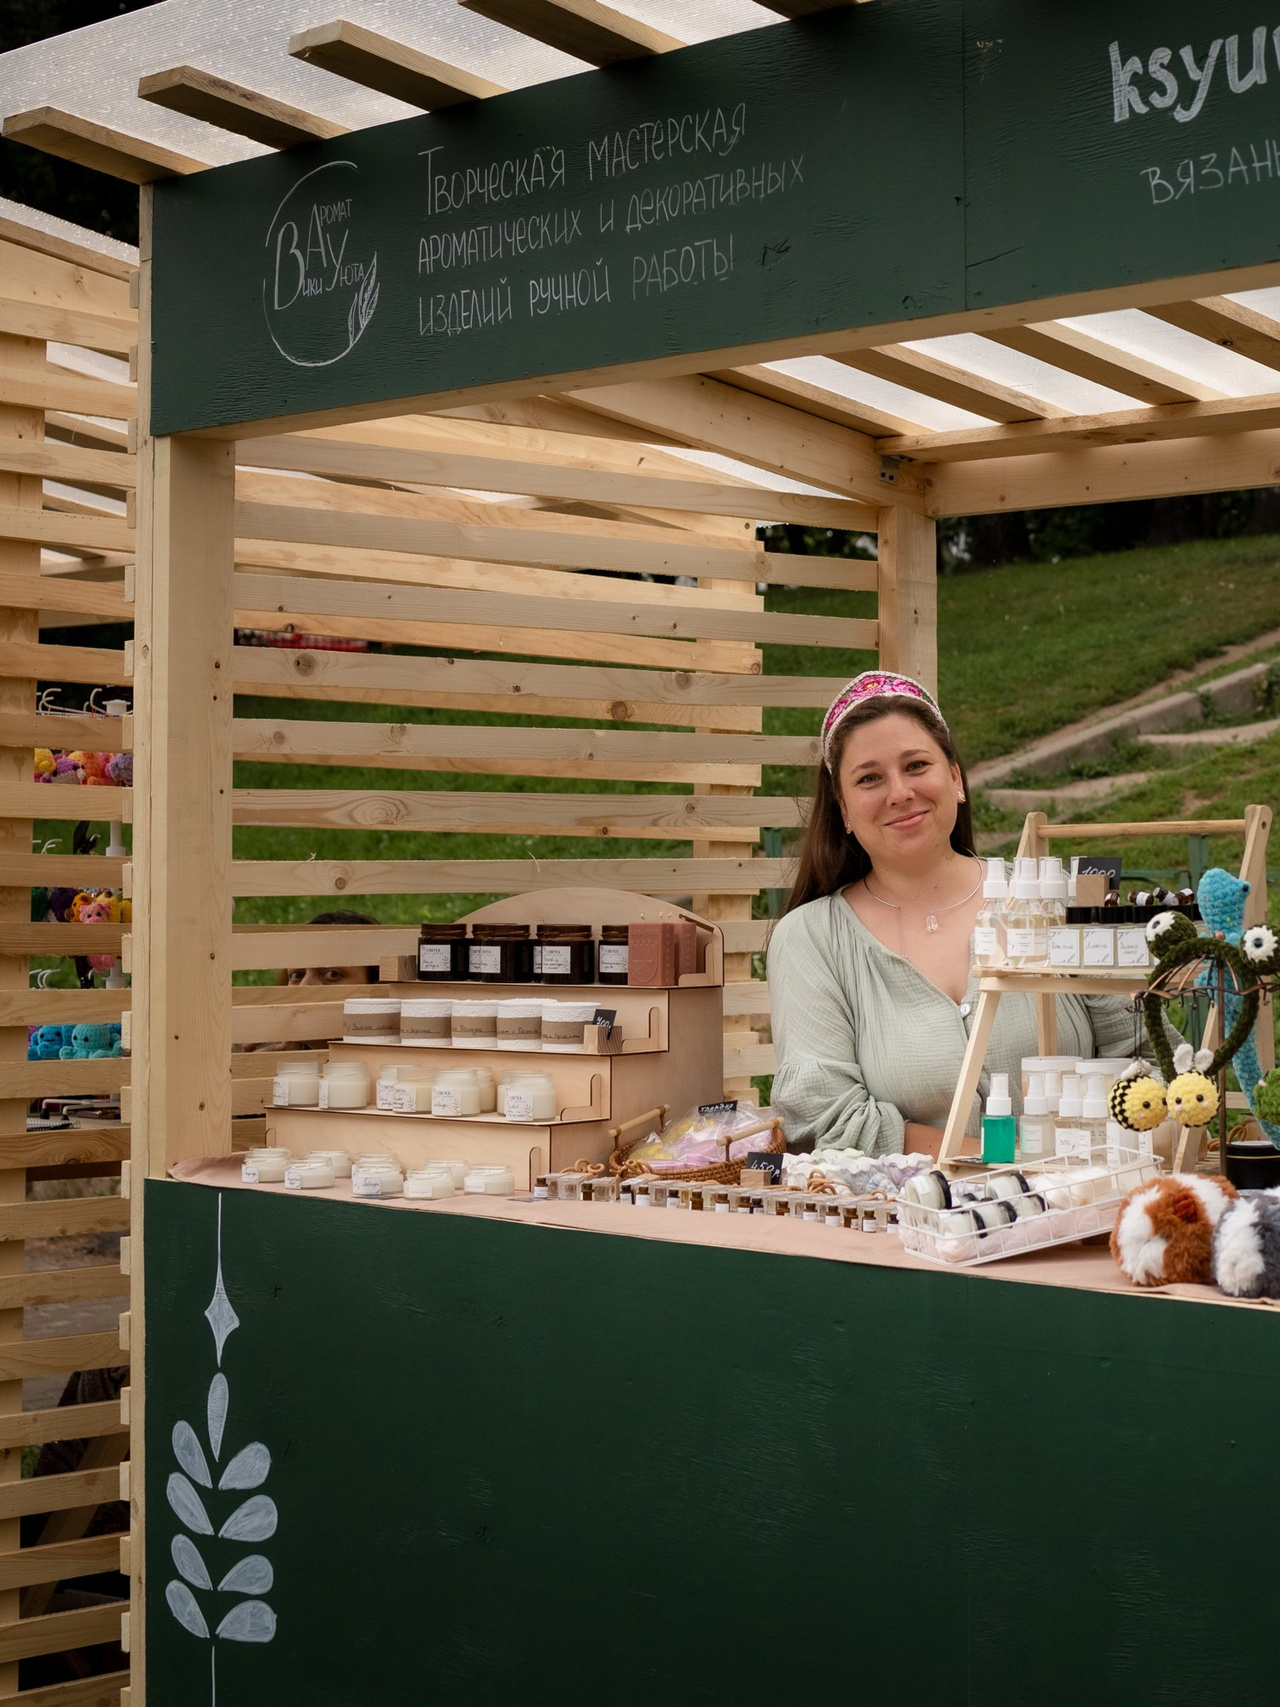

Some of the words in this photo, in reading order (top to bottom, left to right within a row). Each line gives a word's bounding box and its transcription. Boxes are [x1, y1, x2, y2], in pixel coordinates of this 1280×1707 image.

[418, 145, 565, 215] ТВОРЧЕСКАЯ
[589, 103, 746, 181] МАСТЕРСКАЯ
[418, 208, 582, 274] АРОМАТИЧЕСКИХ
[600, 199, 614, 233] И
[625, 154, 804, 235] ДЕКОРАТИВНЫХ
[419, 276, 513, 336] ИЗДЕЛИЙ
[529, 258, 611, 317] РУЧНОЙ
[633, 234, 734, 300] РАБОТЫ
